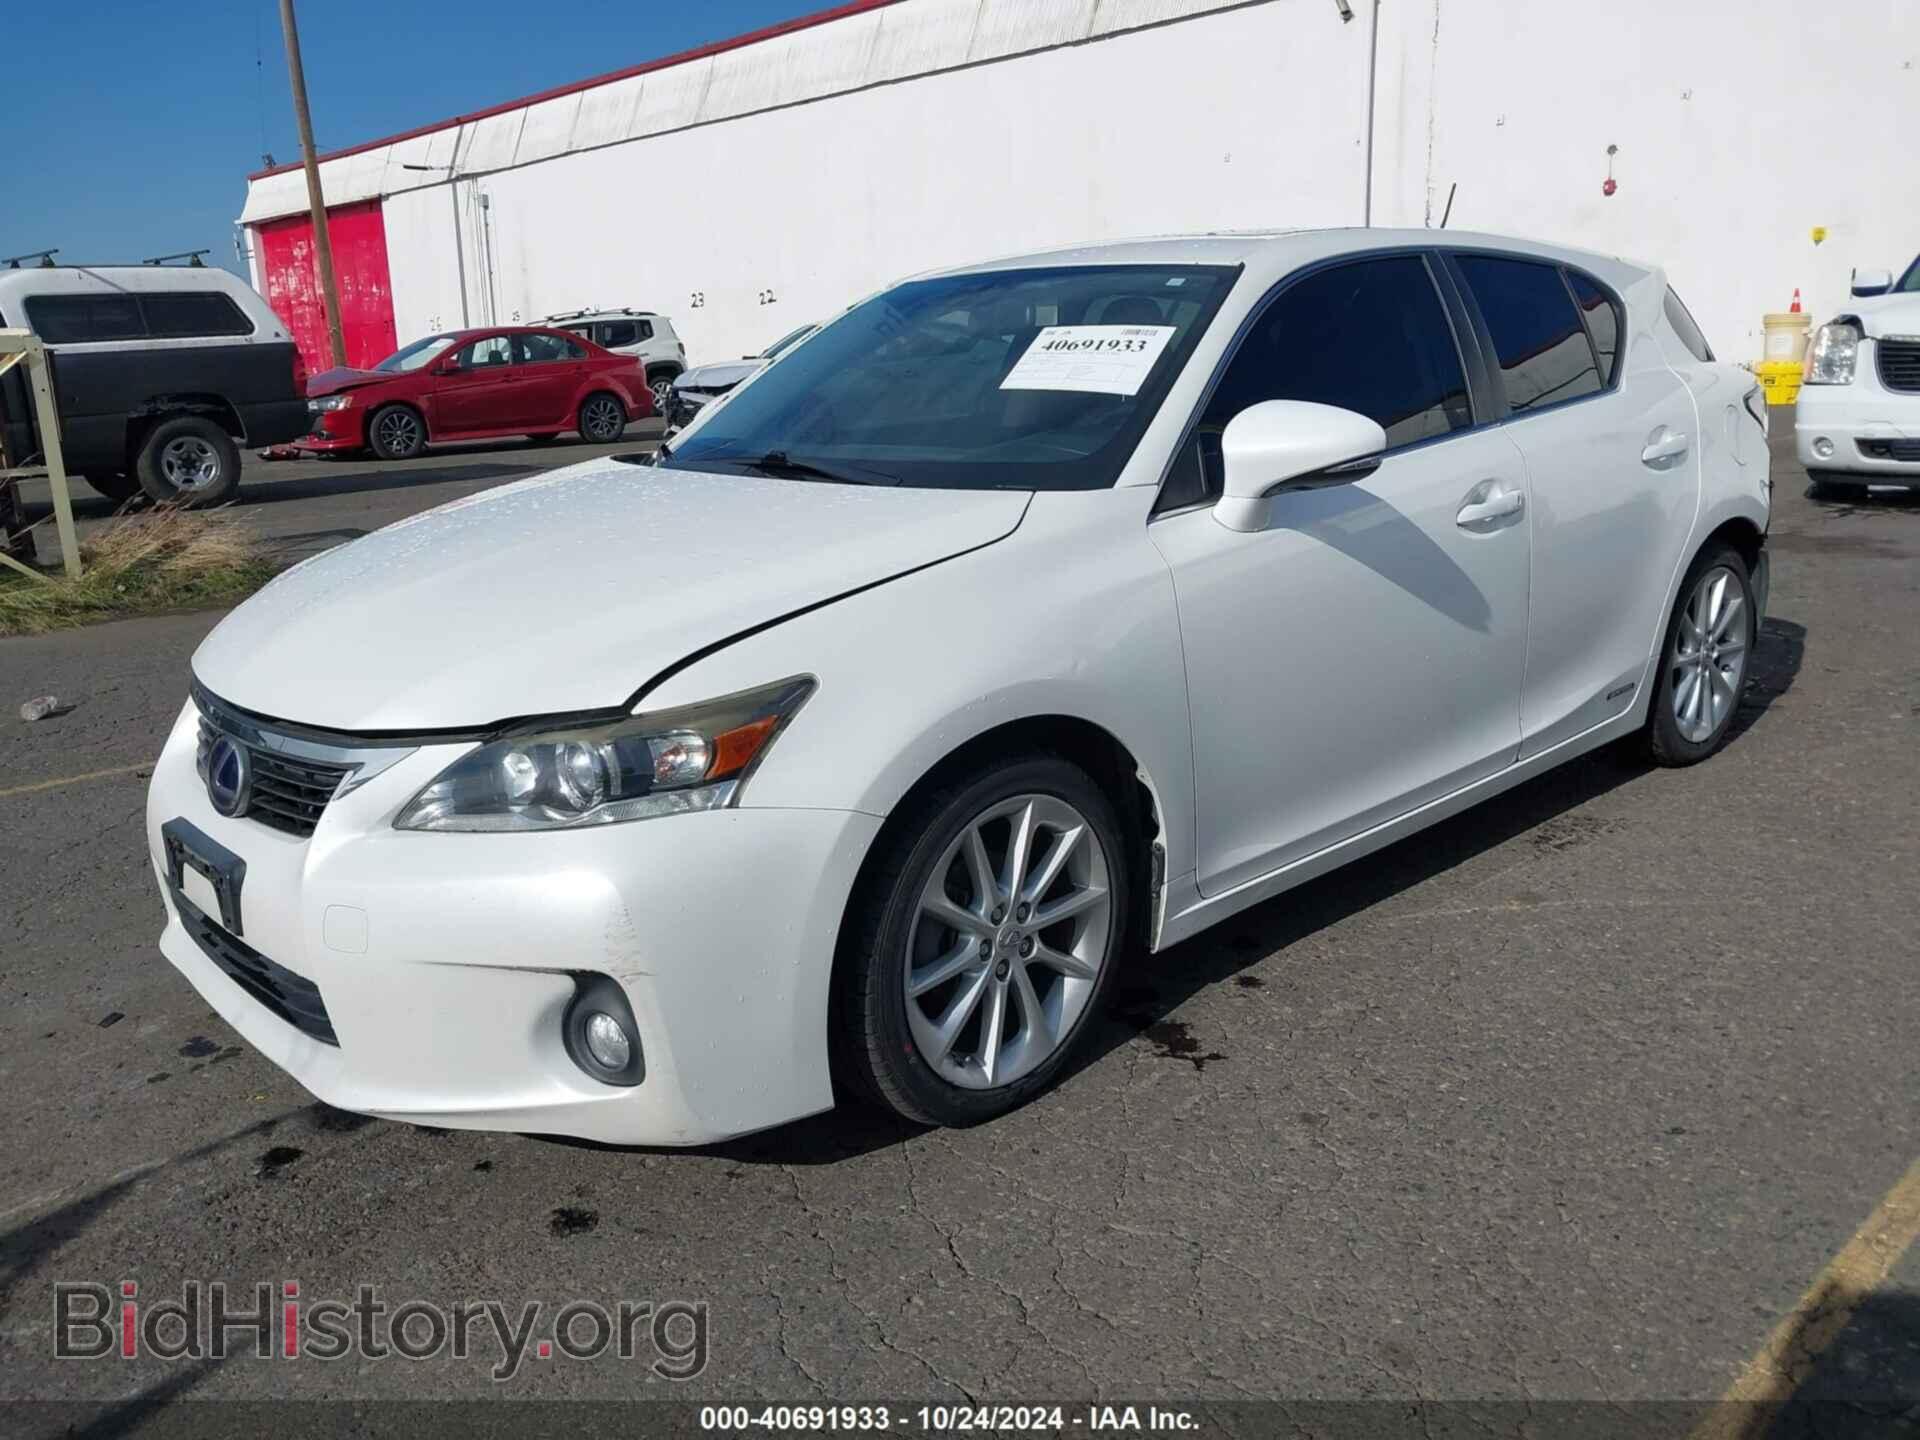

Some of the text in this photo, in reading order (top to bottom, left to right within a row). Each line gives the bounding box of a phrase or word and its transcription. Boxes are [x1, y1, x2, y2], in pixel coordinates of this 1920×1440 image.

[691, 292, 704, 308] 23
[759, 289, 777, 305] 22
[1041, 339, 1147, 352] 40691933
